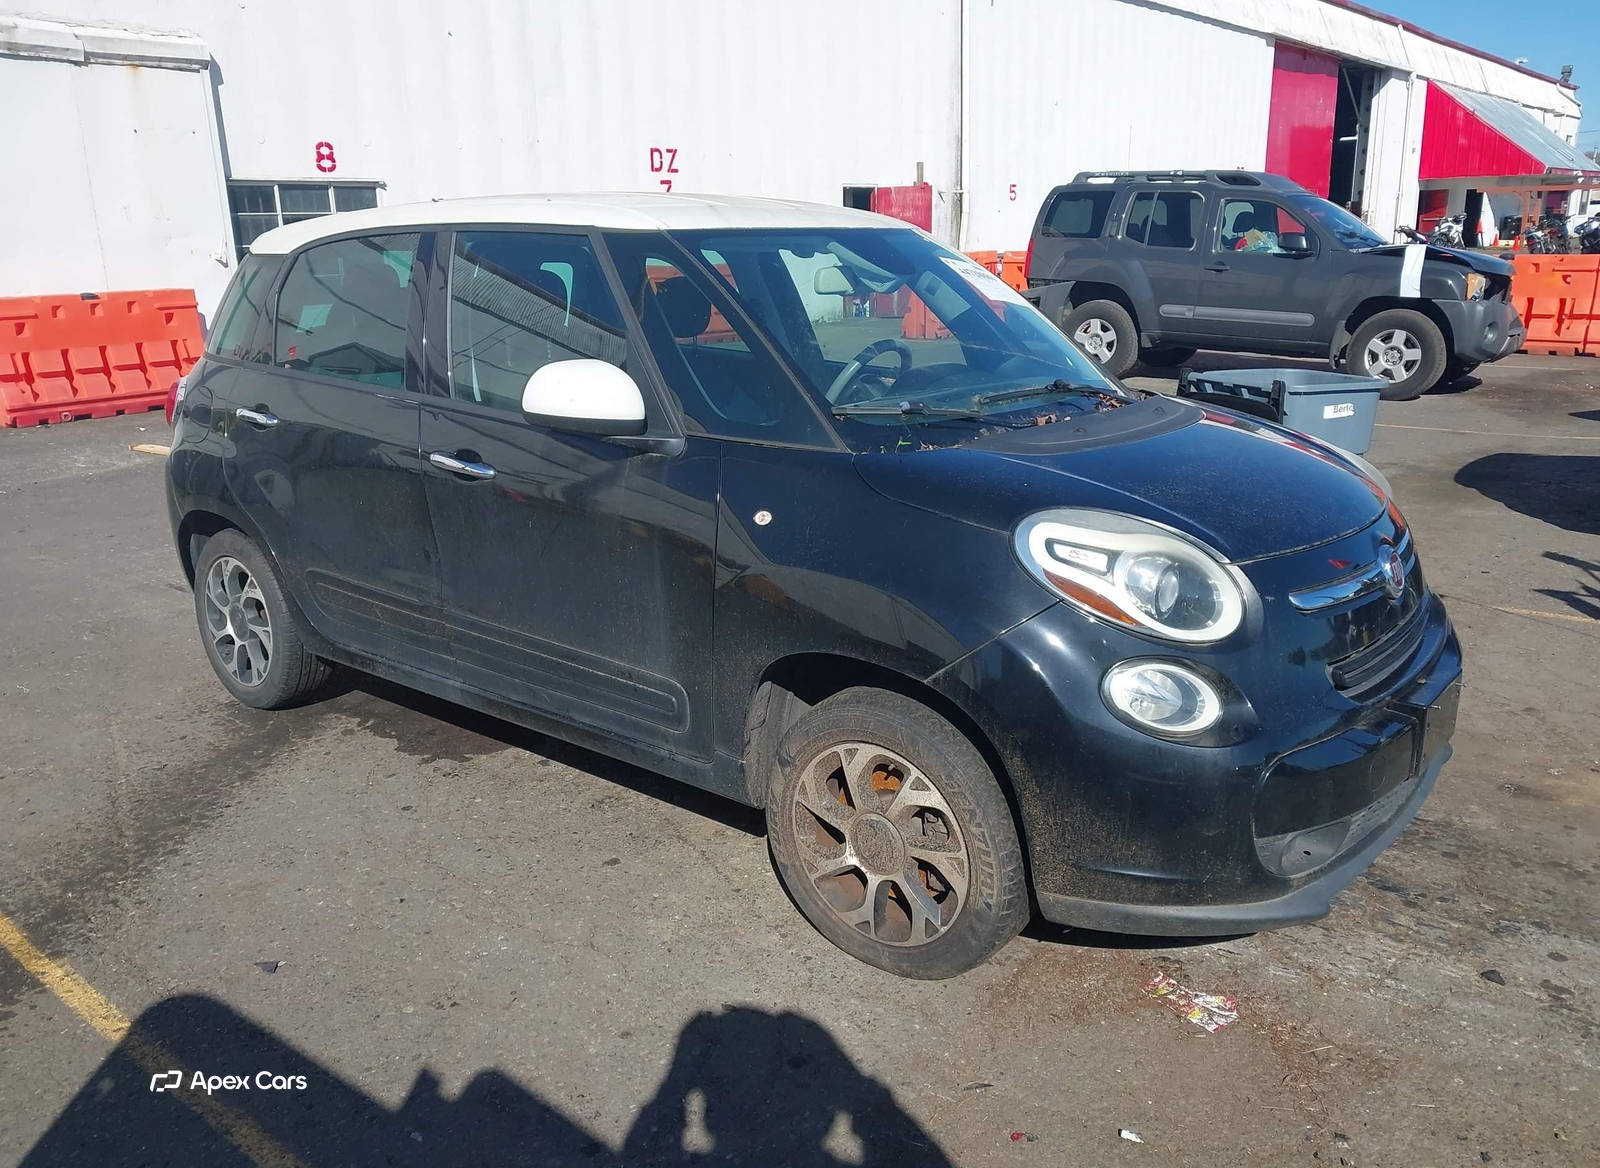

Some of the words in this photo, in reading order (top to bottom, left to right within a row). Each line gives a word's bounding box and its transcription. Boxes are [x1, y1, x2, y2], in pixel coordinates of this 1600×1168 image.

[315, 141, 337, 173] 8
[650, 147, 679, 173] DZ
[1009, 184, 1017, 201] 5
